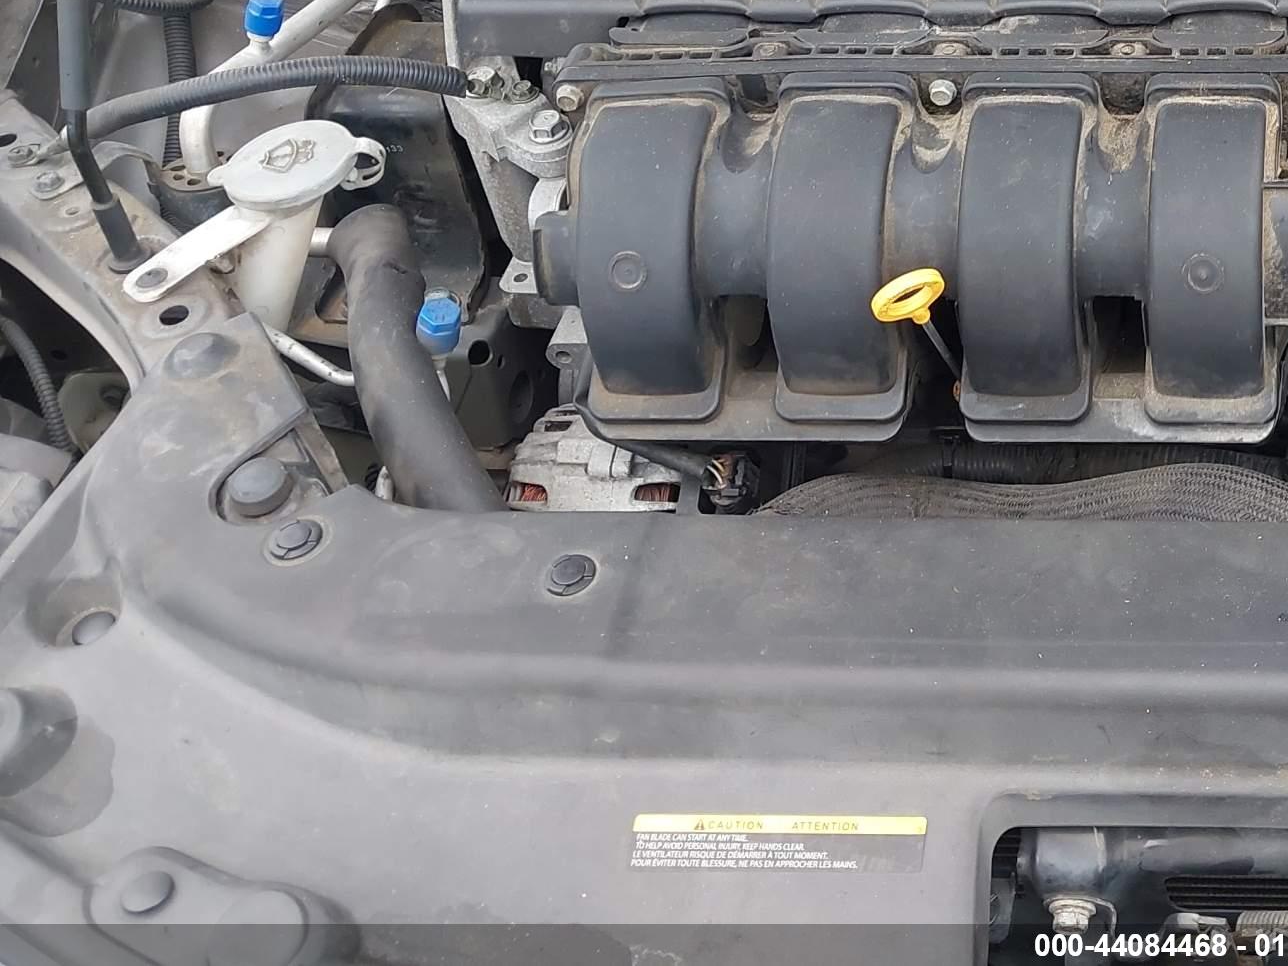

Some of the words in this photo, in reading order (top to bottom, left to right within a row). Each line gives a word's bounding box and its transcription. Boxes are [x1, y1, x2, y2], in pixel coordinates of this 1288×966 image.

[708, 820, 763, 830] CAUTION
[792, 821, 858, 831] ATTENTION
[636, 833, 650, 841] FAN
[650, 833, 671, 841] BLADE
[672, 833, 687, 841] CAN
[687, 833, 707, 841] START
[707, 834, 717, 842] AT
[716, 834, 733, 842] ANY
[636, 841, 645, 849] TO
[645, 842, 662, 850] HELP
[662, 842, 683, 850] AVOID
[684, 842, 717, 850] PERSONAL
[742, 842, 758, 851] KEEP
[758, 842, 783, 851] HANDS
[633, 850, 641, 858] LE
[642, 850, 689, 859] VENTILATEUR
[689, 850, 716, 859] RISQUE
[716, 851, 728, 859] DE
[773, 851, 793, 860] TOUT
[630, 858, 652, 867] POUR
[677, 859, 700, 867] TOUTE
[738, 859, 749, 868] NE
[749, 860, 765, 868] PAS
[764, 860, 775, 868] EN
[774, 860, 818, 869] APPROCHER
[819, 861, 832, 869] LES
